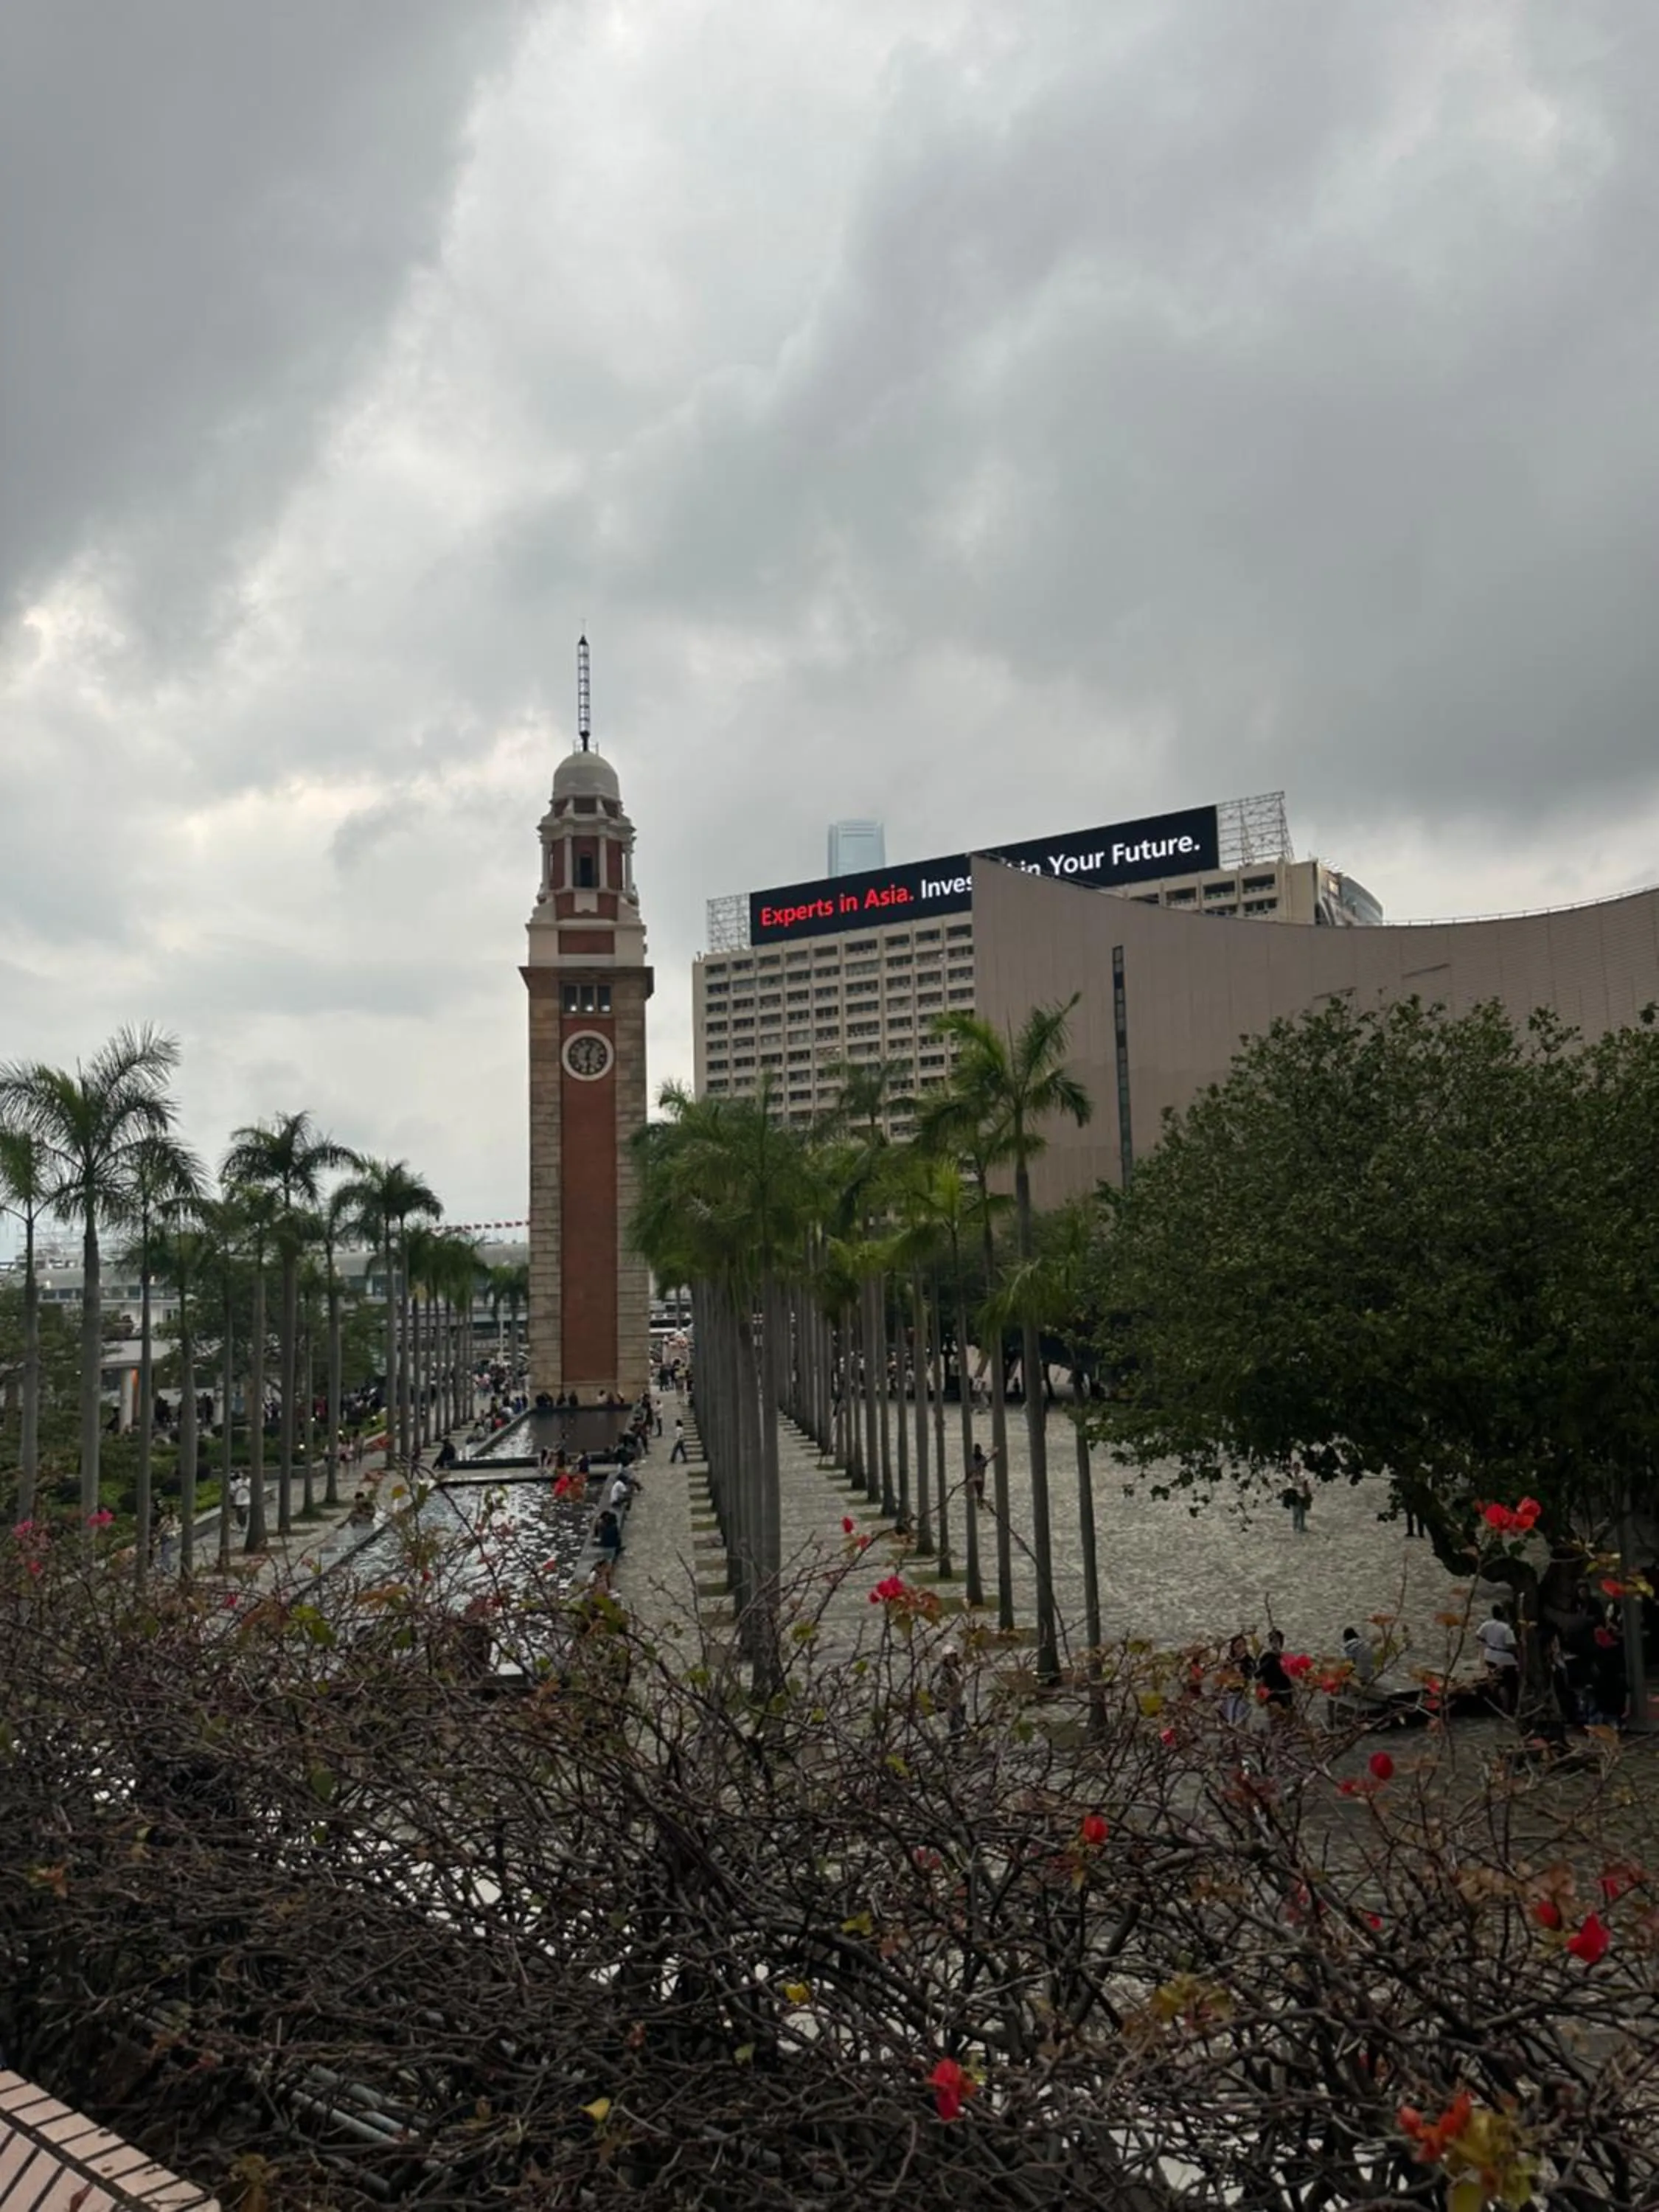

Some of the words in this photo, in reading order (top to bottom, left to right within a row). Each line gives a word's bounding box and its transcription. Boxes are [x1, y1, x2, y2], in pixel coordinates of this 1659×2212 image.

[761, 899, 833, 927] Experts
[839, 893, 858, 913] in
[864, 883, 914, 909] Asia.
[921, 875, 973, 899] Inves
[1048, 851, 1105, 875] Your
[1112, 835, 1200, 865] Future.
